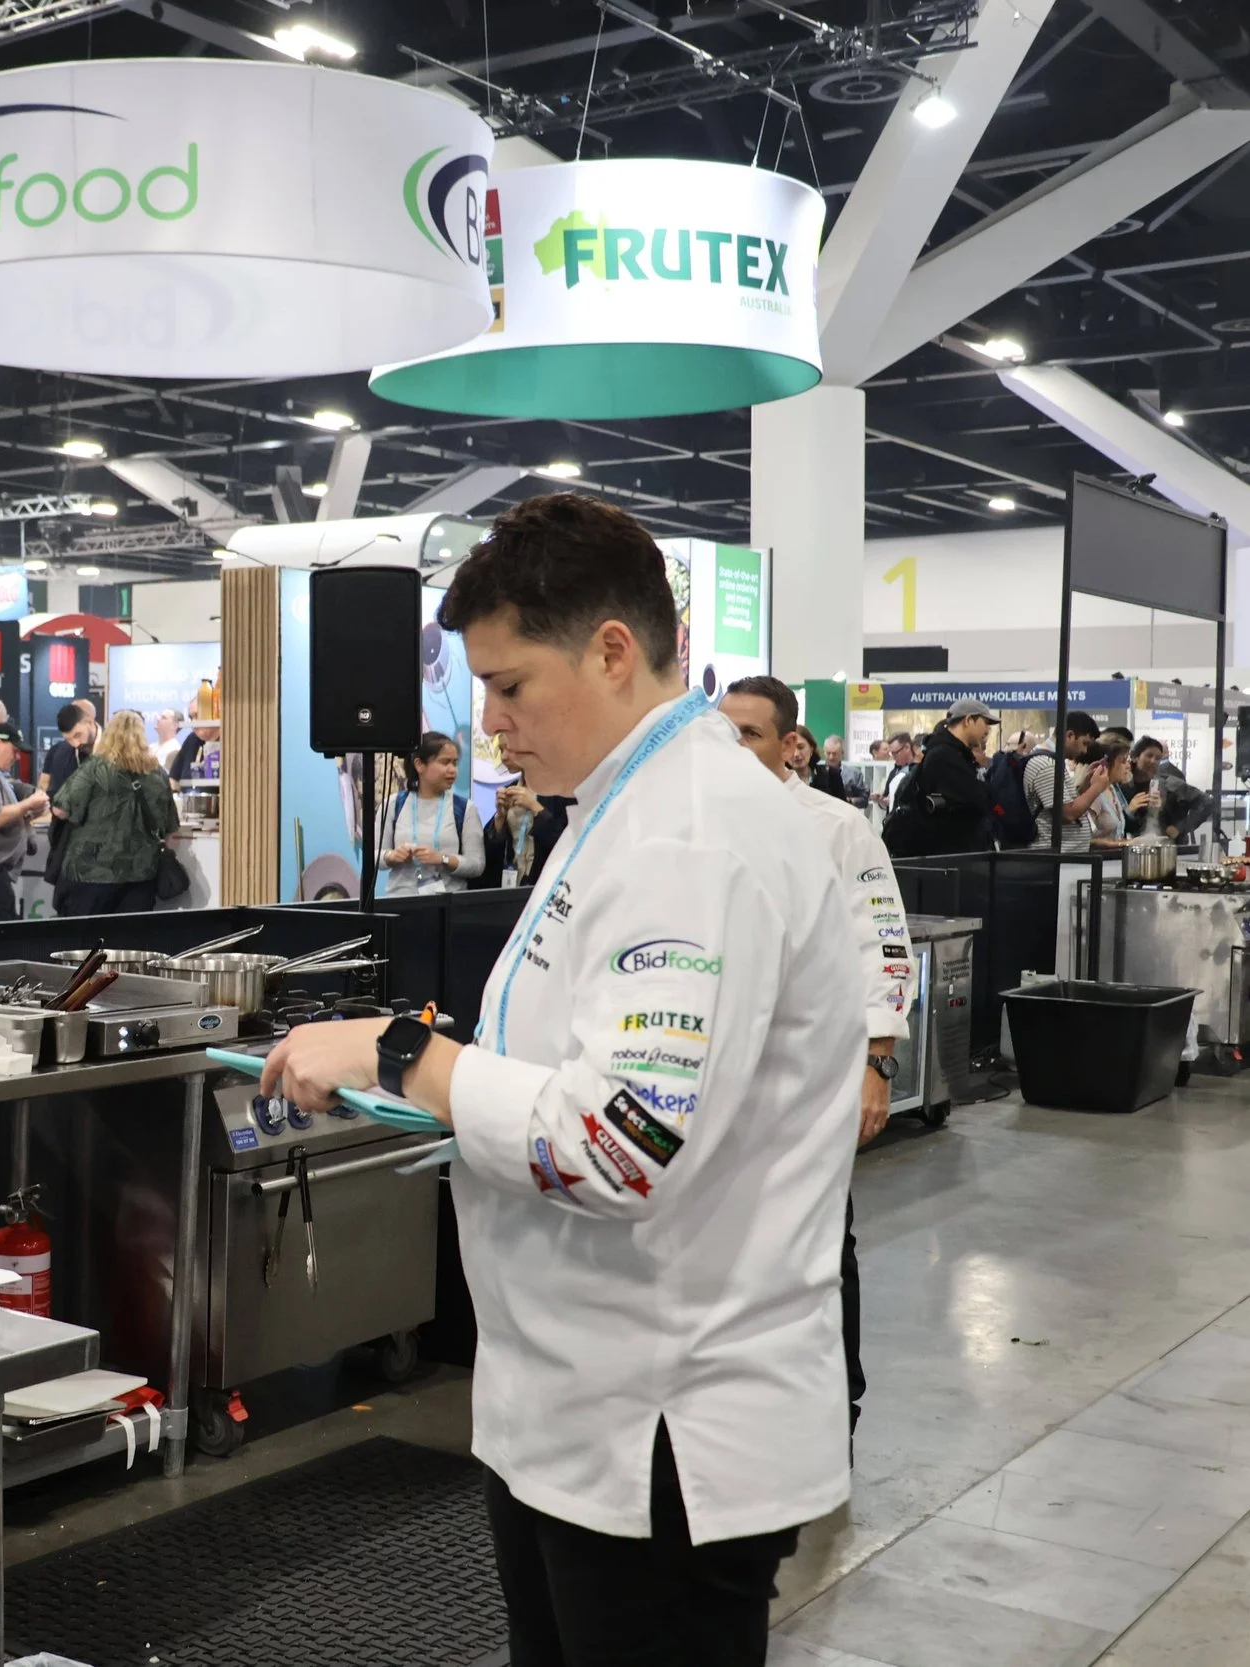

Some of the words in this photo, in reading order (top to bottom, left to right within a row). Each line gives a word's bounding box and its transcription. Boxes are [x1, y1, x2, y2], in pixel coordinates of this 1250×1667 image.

[563, 228, 790, 296] FRUTEX
[739, 296, 792, 317] AUSTRALIA
[910, 691, 977, 703] AUSTRALIAN
[978, 690, 1045, 702] WHOLESALE
[1047, 690, 1087, 702] MATS
[633, 950, 723, 975] Bidfood
[624, 1011, 704, 1033] FRUTEX
[611, 1048, 647, 1060] robot
[595, 1128, 641, 1182] QUEEN
